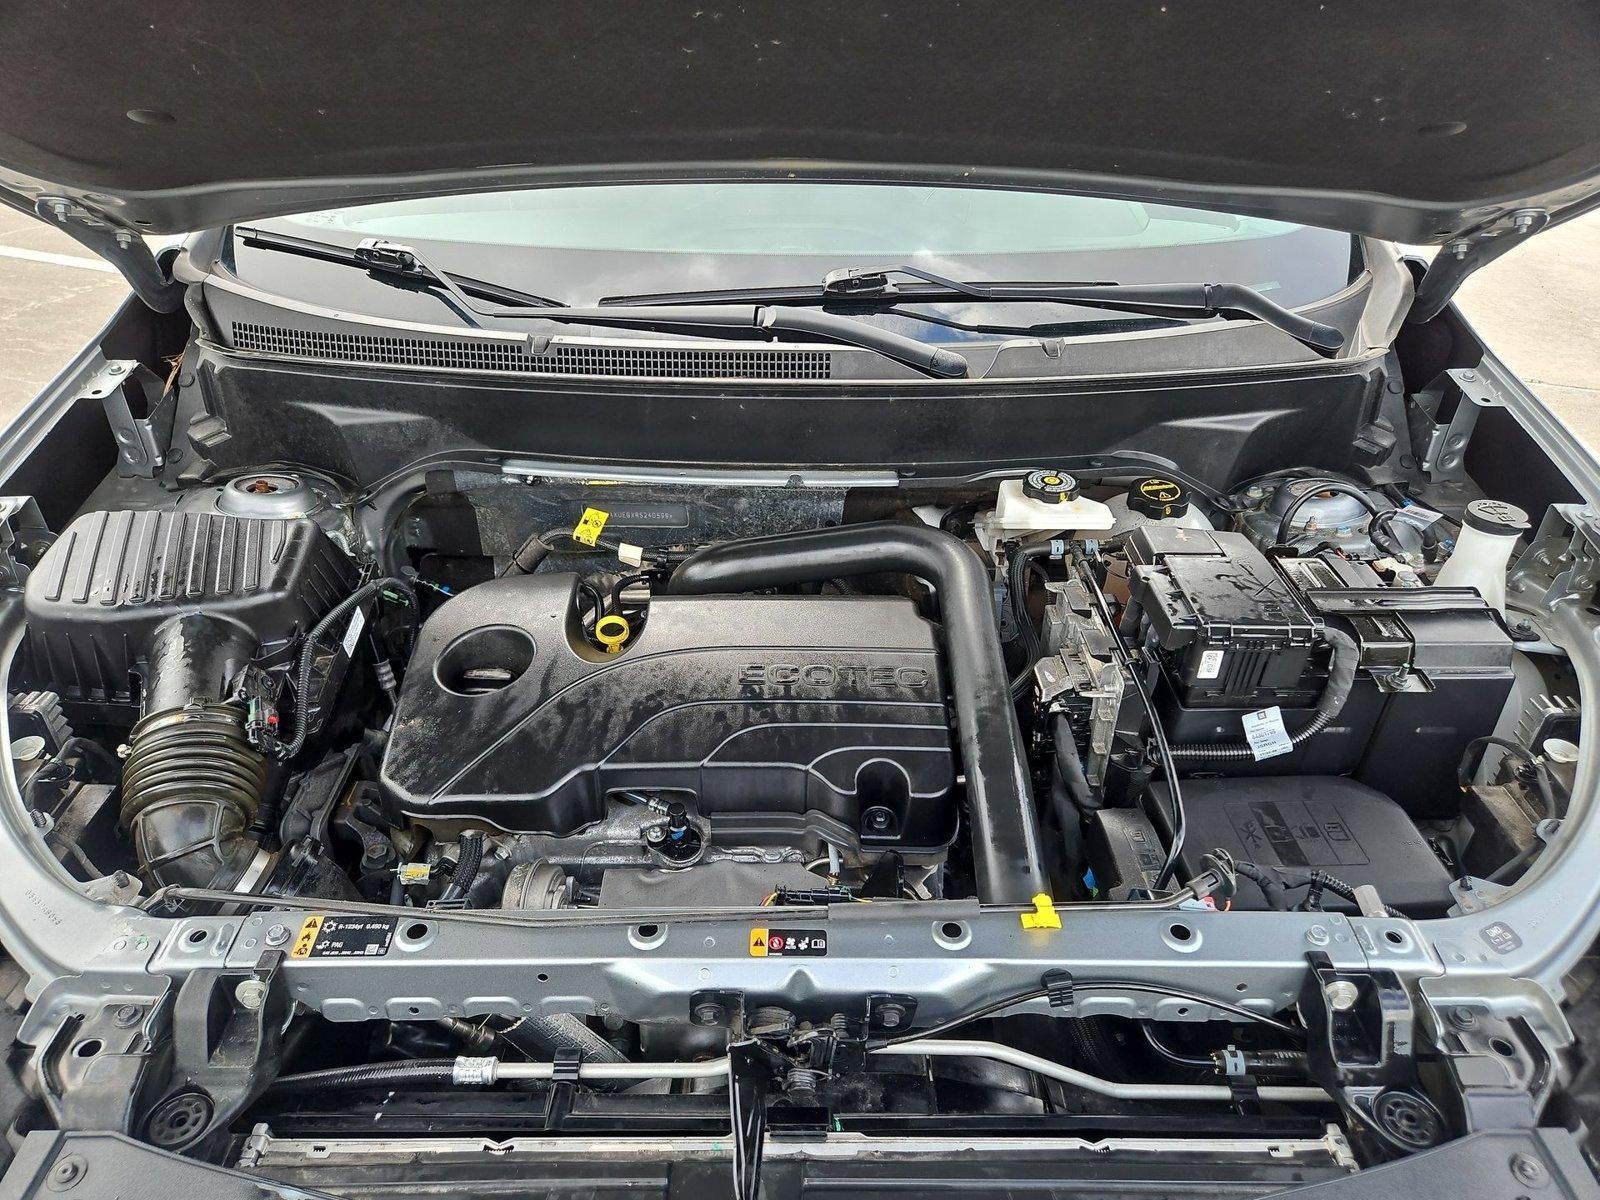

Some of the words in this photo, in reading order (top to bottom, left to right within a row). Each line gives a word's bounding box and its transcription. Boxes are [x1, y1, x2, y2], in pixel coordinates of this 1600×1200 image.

[738, 664, 928, 688] ECOTEC
[338, 923, 364, 931] R-1234yf
[331, 941, 344, 949] PAG
